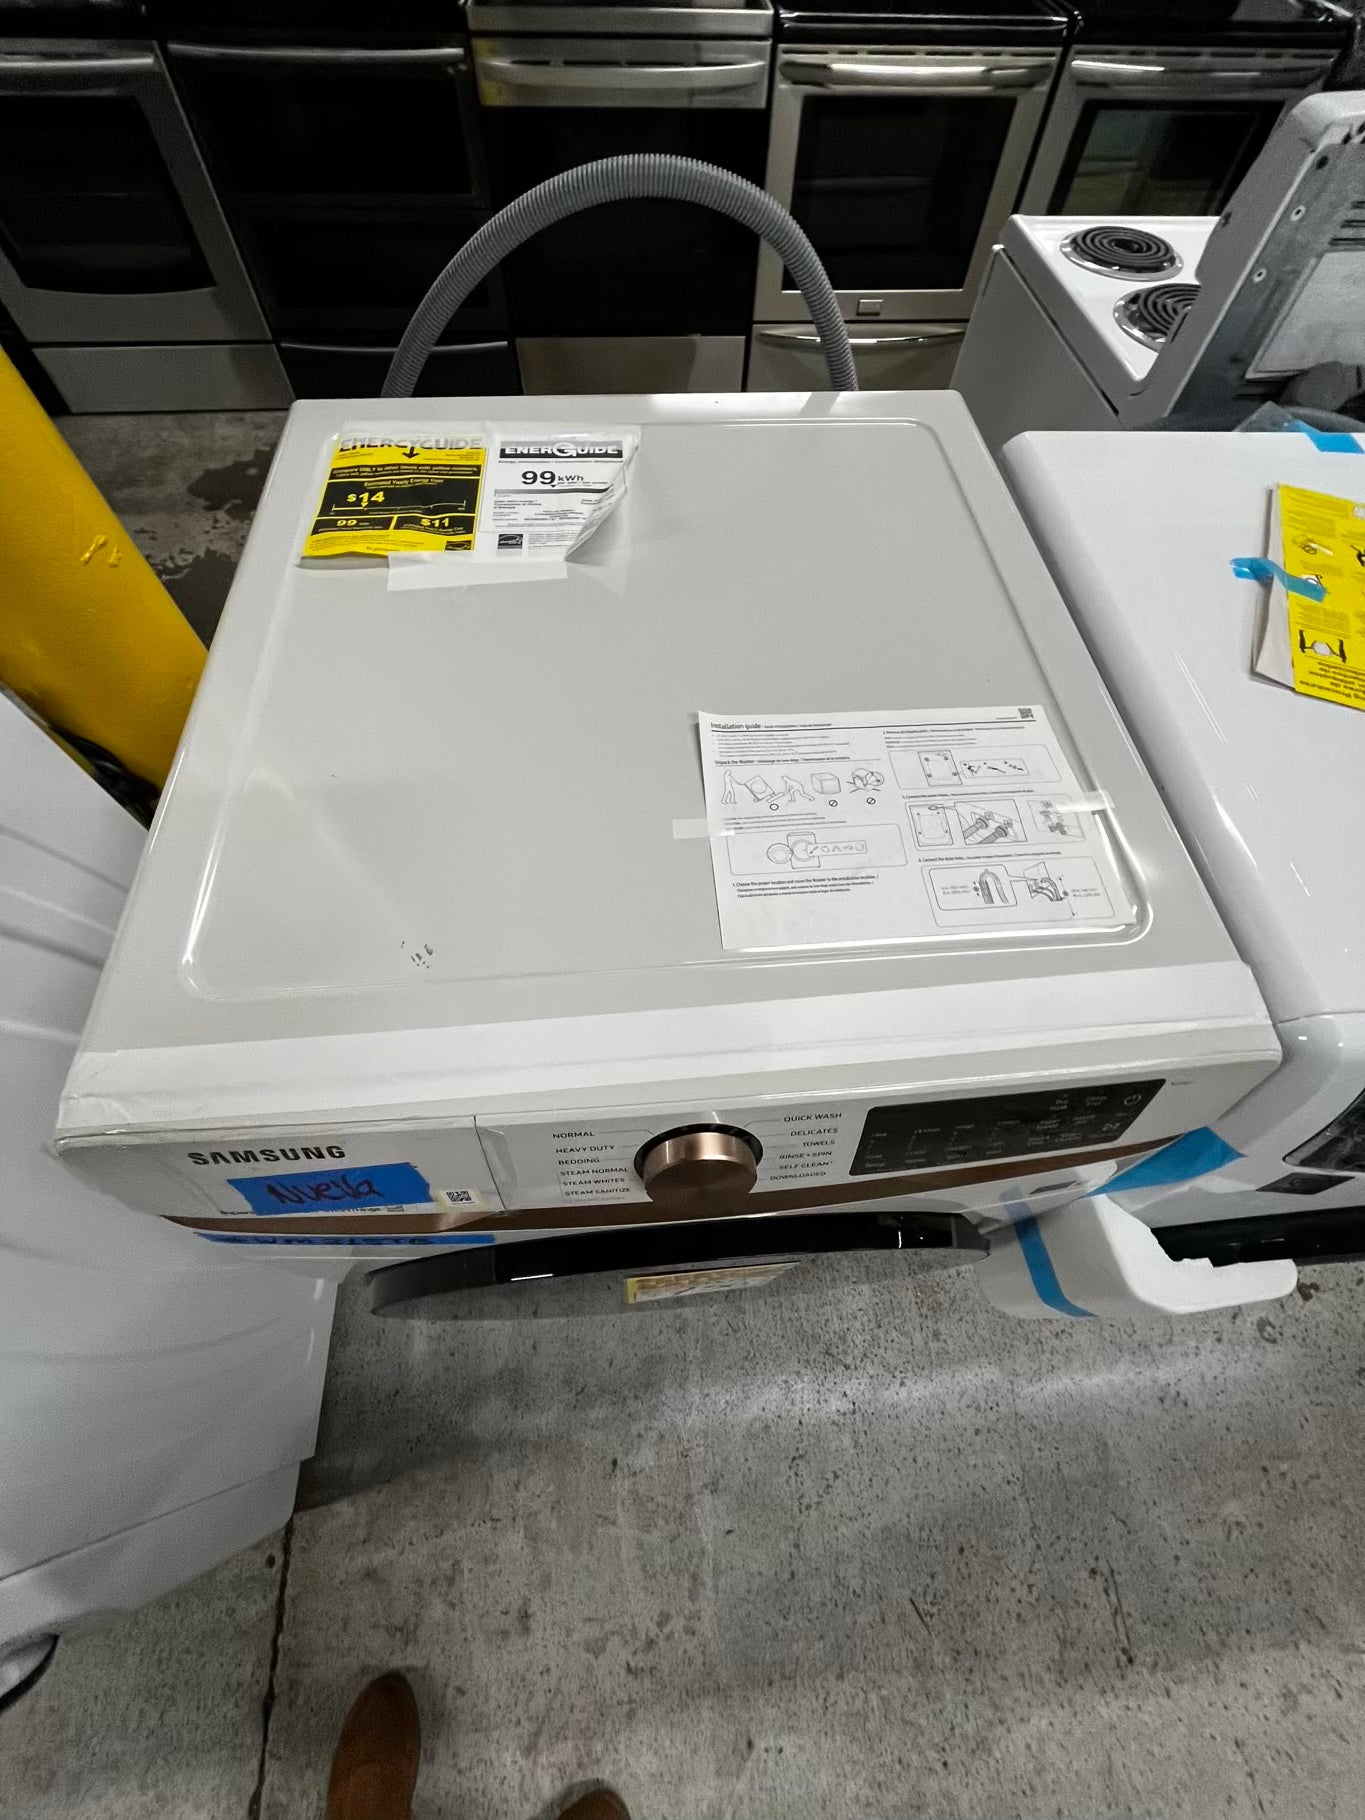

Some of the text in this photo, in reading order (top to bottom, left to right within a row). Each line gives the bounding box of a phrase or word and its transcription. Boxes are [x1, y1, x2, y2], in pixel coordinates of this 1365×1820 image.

[504, 442, 618, 457] ENERGUIDE
[521, 470, 556, 485] 99
[347, 491, 385, 503] $14
[336, 519, 358, 527] 99
[420, 518, 450, 527] $11
[710, 722, 745, 730] Installation
[784, 1112, 842, 1122] QUICK WASH
[552, 1131, 595, 1139] NORMAL
[790, 1127, 838, 1136] DELICATES
[556, 1146, 587, 1154] HEAVY
[187, 1145, 346, 1166] SAMSUNG
[558, 1157, 600, 1166] BEDDING
[593, 1177, 625, 1185] WHITES
[769, 1172, 827, 1181] DOWNLOADED
[565, 1187, 631, 1197] STEAM SANITIZE
